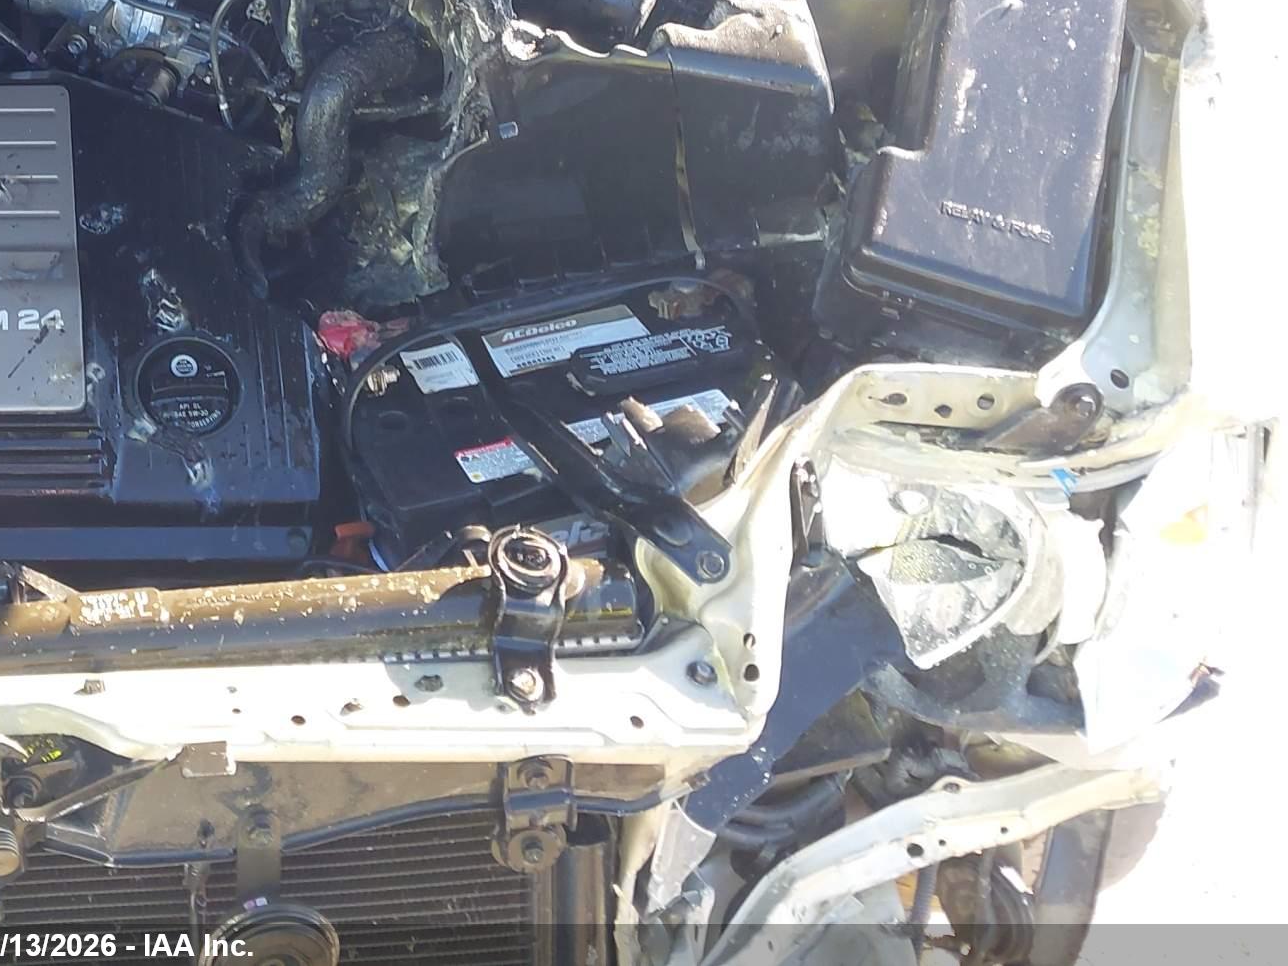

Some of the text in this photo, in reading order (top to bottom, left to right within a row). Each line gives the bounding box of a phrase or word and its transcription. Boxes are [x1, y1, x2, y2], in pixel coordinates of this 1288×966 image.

[1009, 219, 1053, 244] FUSE
[18, 308, 64, 331] 24
[501, 319, 577, 343] ACDelco
